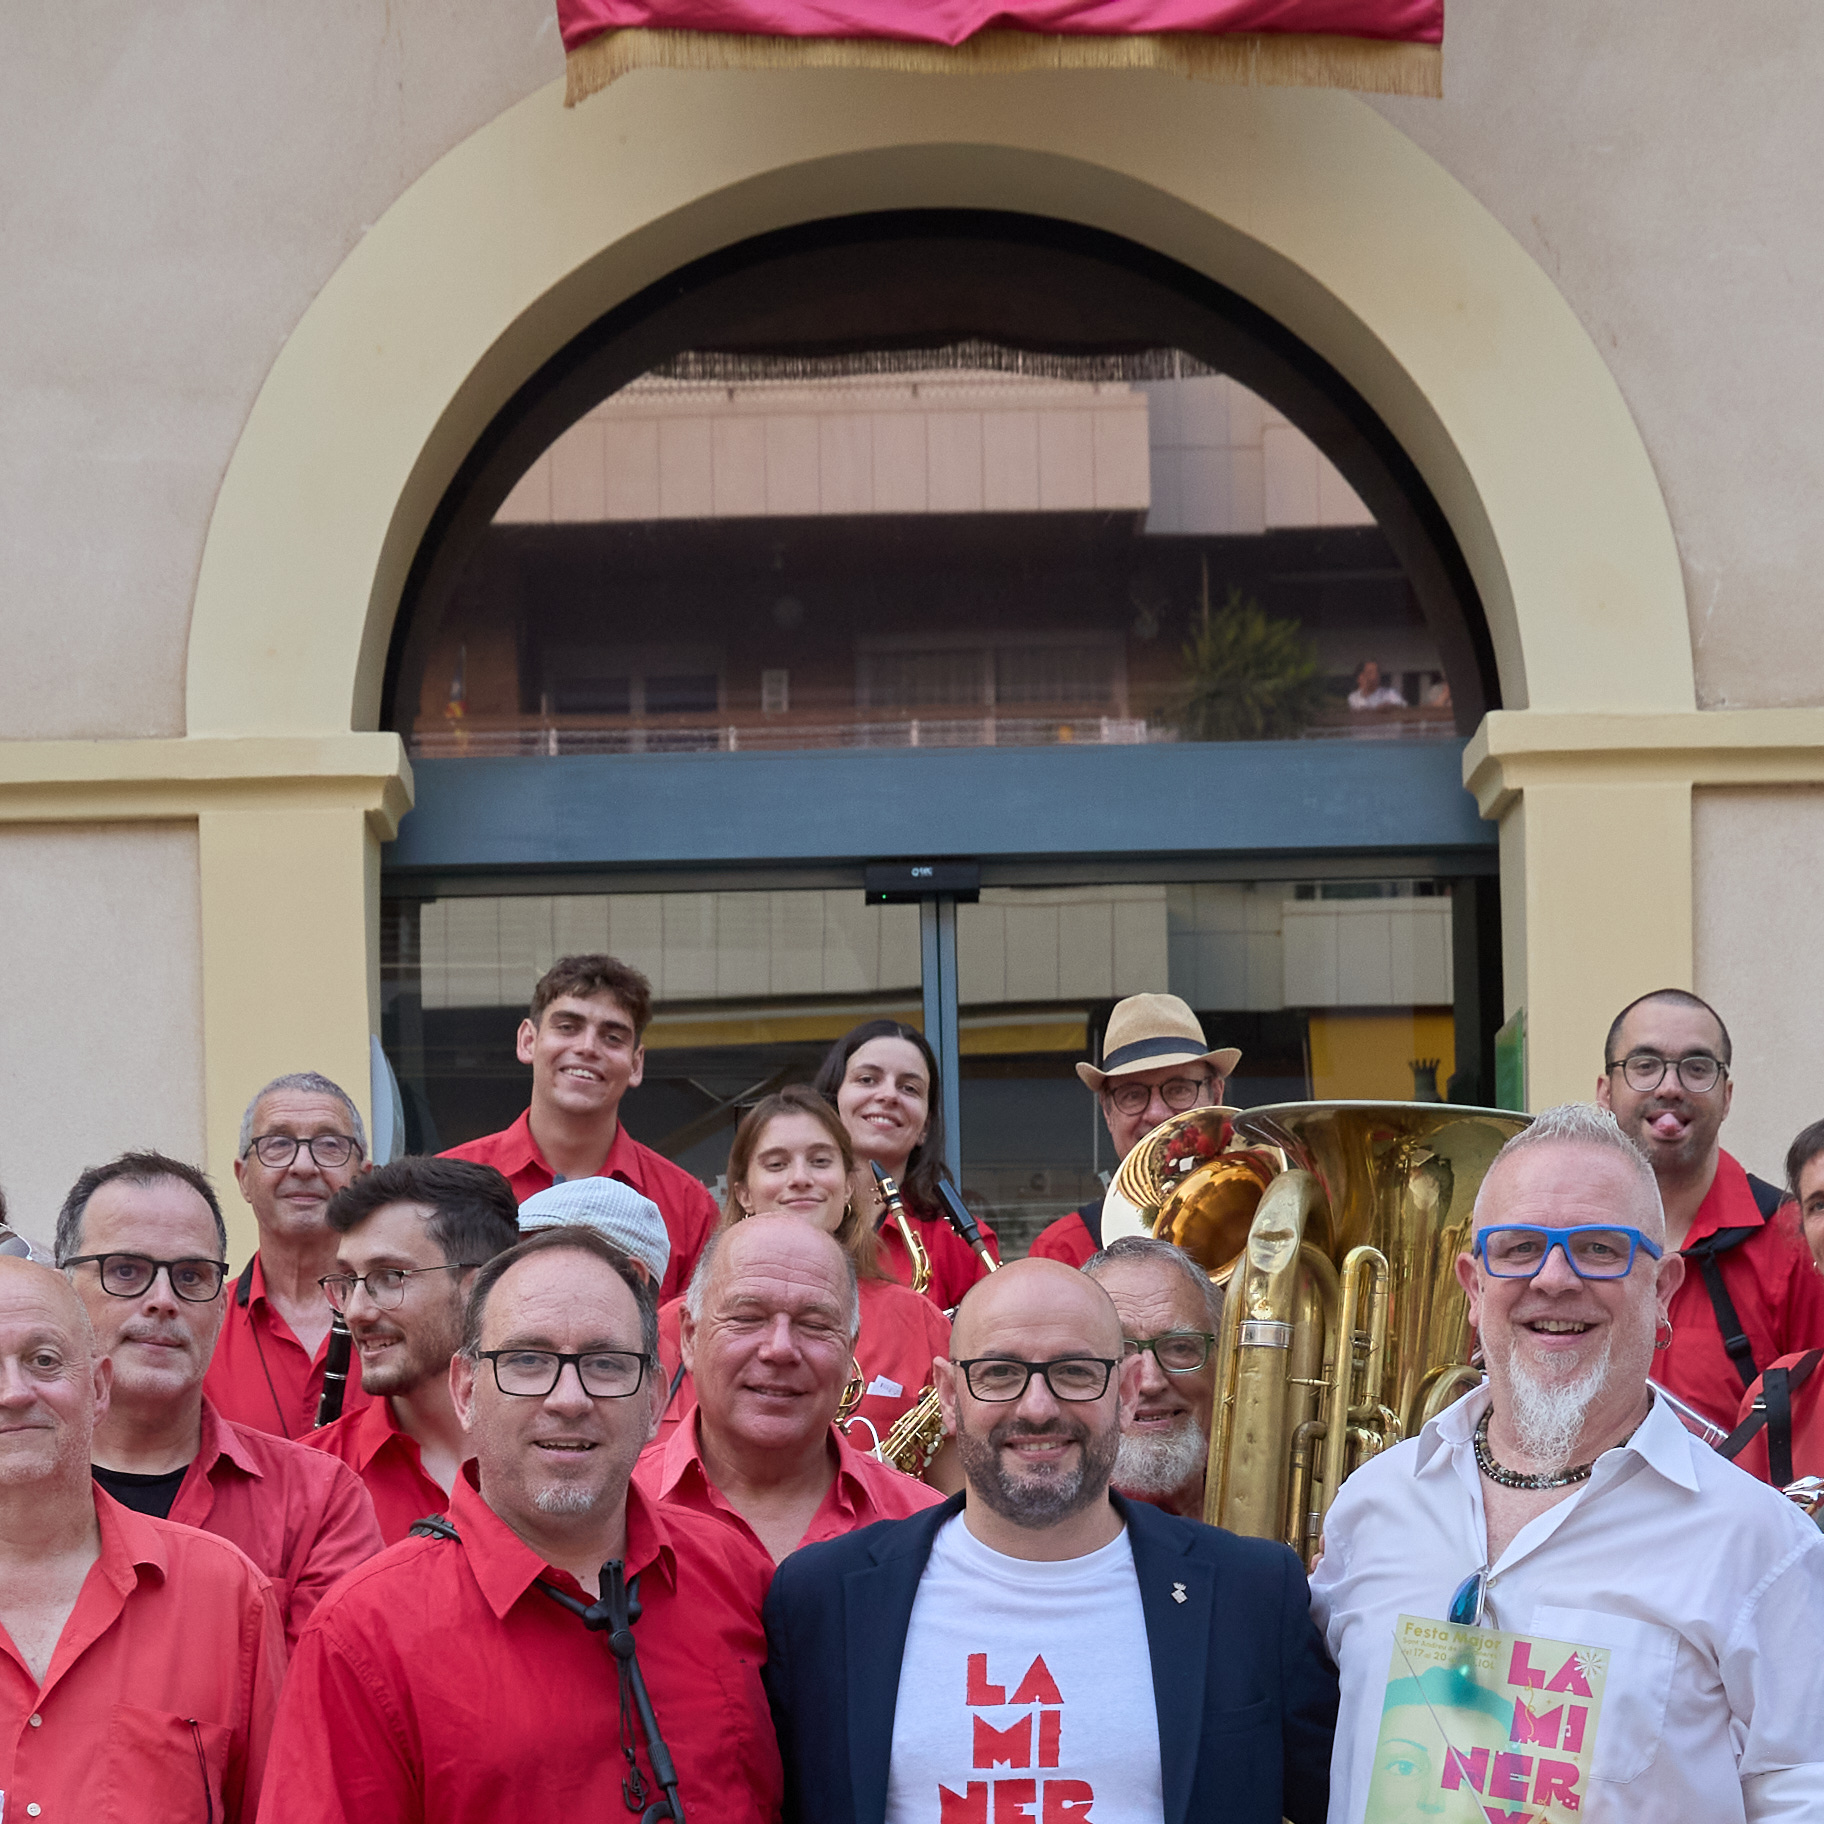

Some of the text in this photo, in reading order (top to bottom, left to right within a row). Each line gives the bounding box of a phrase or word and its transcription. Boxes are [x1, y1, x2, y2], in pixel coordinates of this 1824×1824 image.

[1404, 1622, 1502, 1650] Festa Major
[1414, 1648, 1425, 1657] 17
[1433, 1651, 1447, 1661] 20
[965, 1652, 1065, 1706] LA
[1507, 1640, 1594, 1698] LA
[972, 1709, 1062, 1769] MI
[1509, 1696, 1589, 1753] MI
[1441, 1745, 1581, 1811] NER
